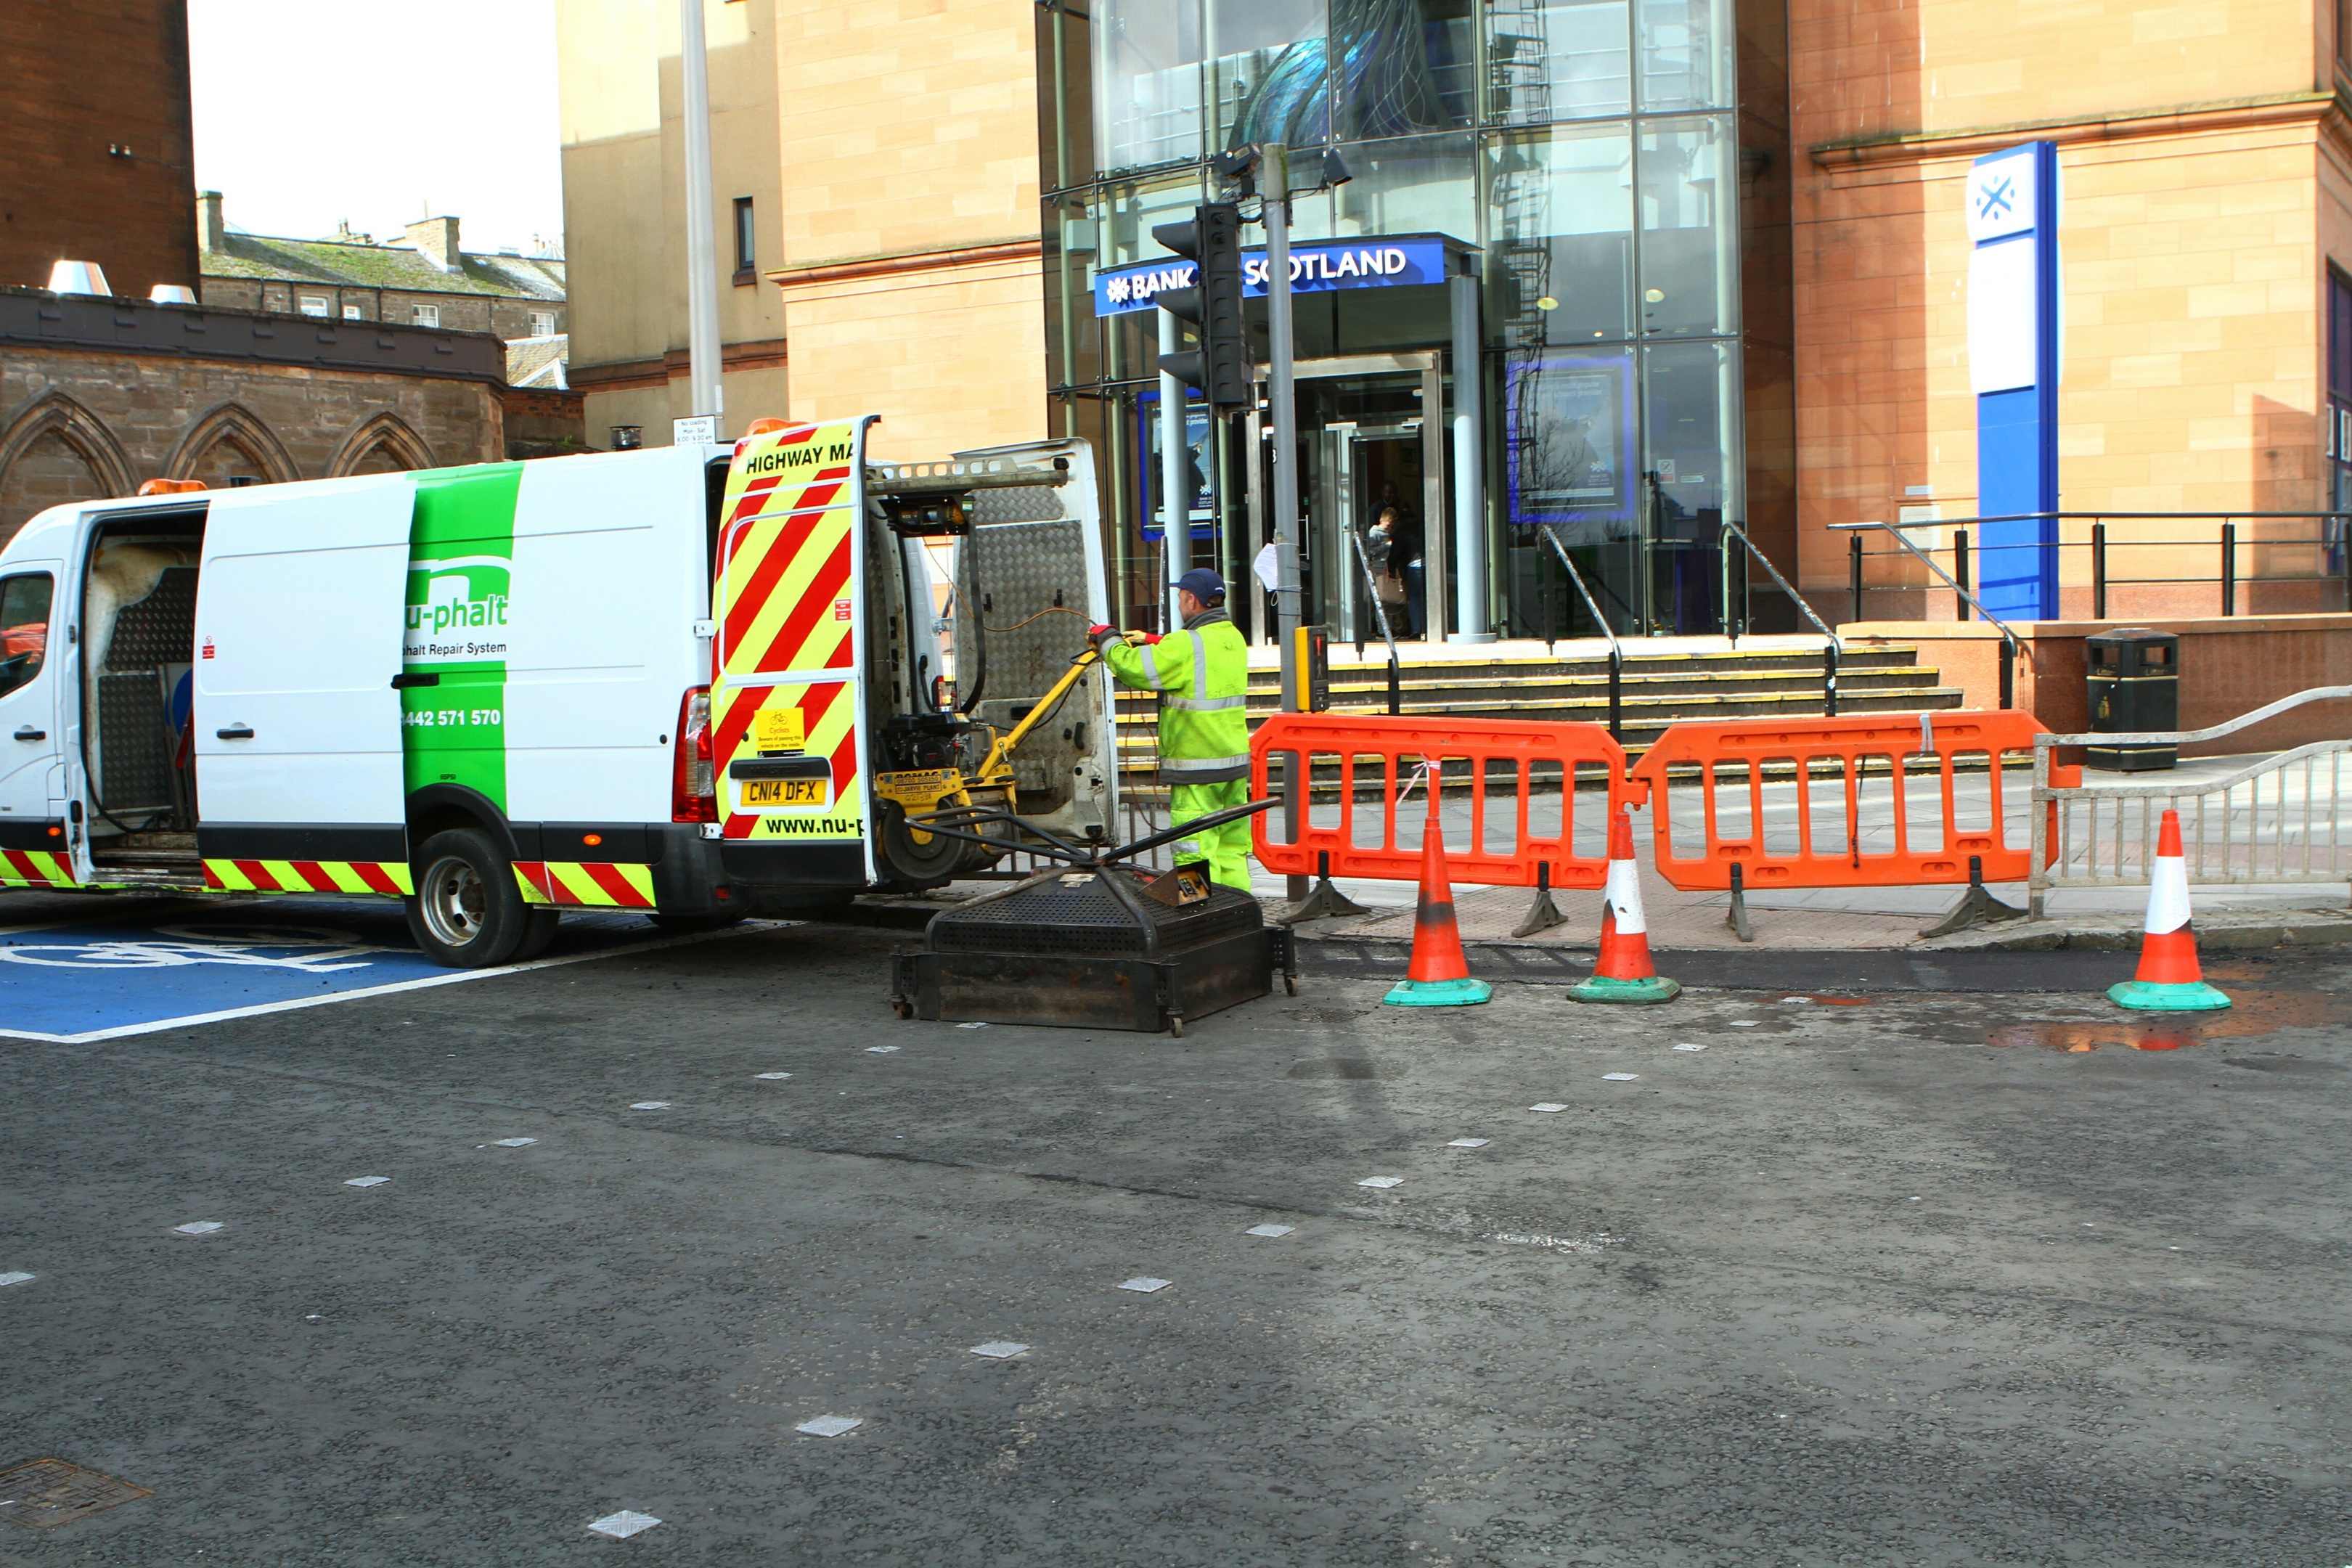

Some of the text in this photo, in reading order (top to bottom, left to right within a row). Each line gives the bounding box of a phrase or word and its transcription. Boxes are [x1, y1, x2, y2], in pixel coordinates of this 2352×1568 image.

[1132, 267, 1194, 299] BANK
[746, 446, 823, 474] HIGHWAY
[429, 643, 464, 658] Repair
[467, 642, 507, 656] System
[438, 710, 465, 726] 571
[471, 709, 501, 725] 570
[750, 766, 802, 775] MASTER
[749, 781, 817, 801] CN14 DFX
[766, 818, 865, 837] www.nu-p
